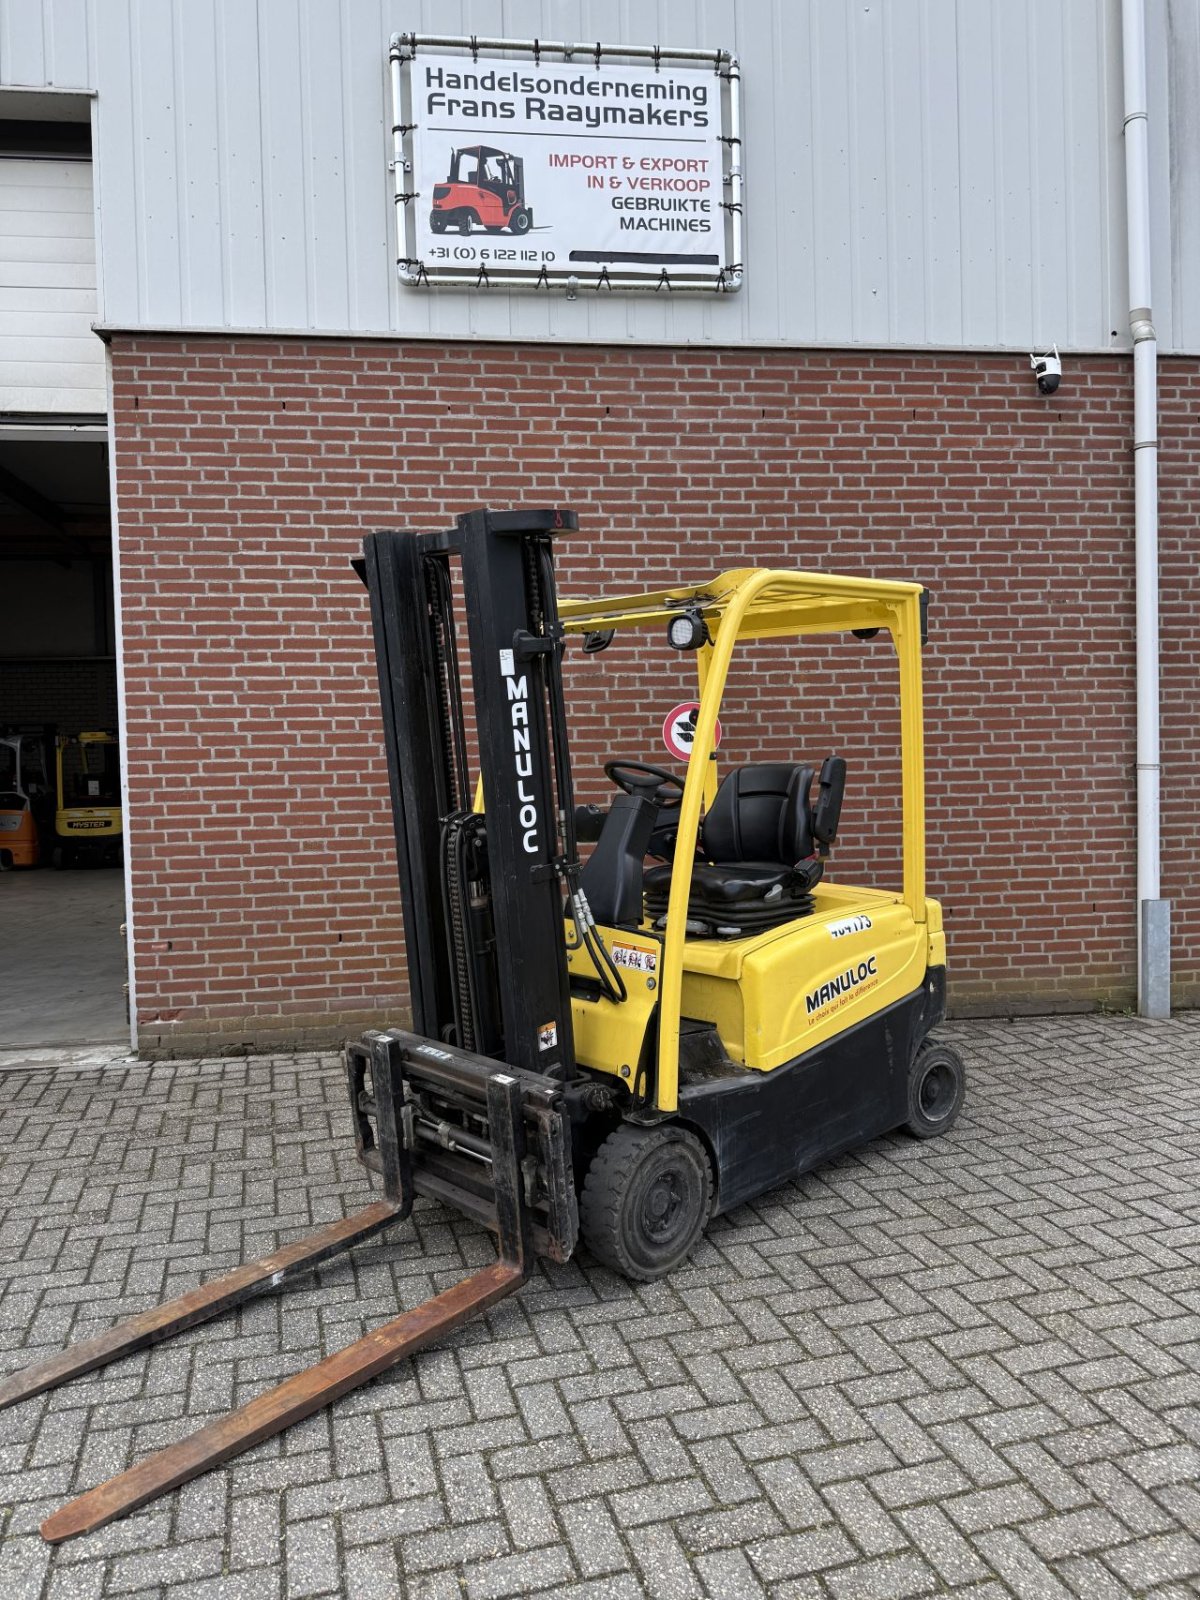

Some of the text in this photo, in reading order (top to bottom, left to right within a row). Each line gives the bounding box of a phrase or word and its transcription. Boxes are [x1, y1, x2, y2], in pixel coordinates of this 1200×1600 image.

[425, 67, 707, 106] Handelsonderneming
[427, 93, 709, 128] Frans Raaymakers
[549, 153, 709, 173] IMPORT & EXPORT
[587, 175, 711, 193] IN & VERKOOP
[611, 196, 711, 213] GEBRUIKTE
[619, 216, 712, 233] MACHINES
[429, 246, 556, 262] +31 (0) 6 122 112 10
[506, 675, 538, 853] MANULOC
[72, 821, 105, 829] HYSTER
[806, 956, 877, 1013] MANULOC
